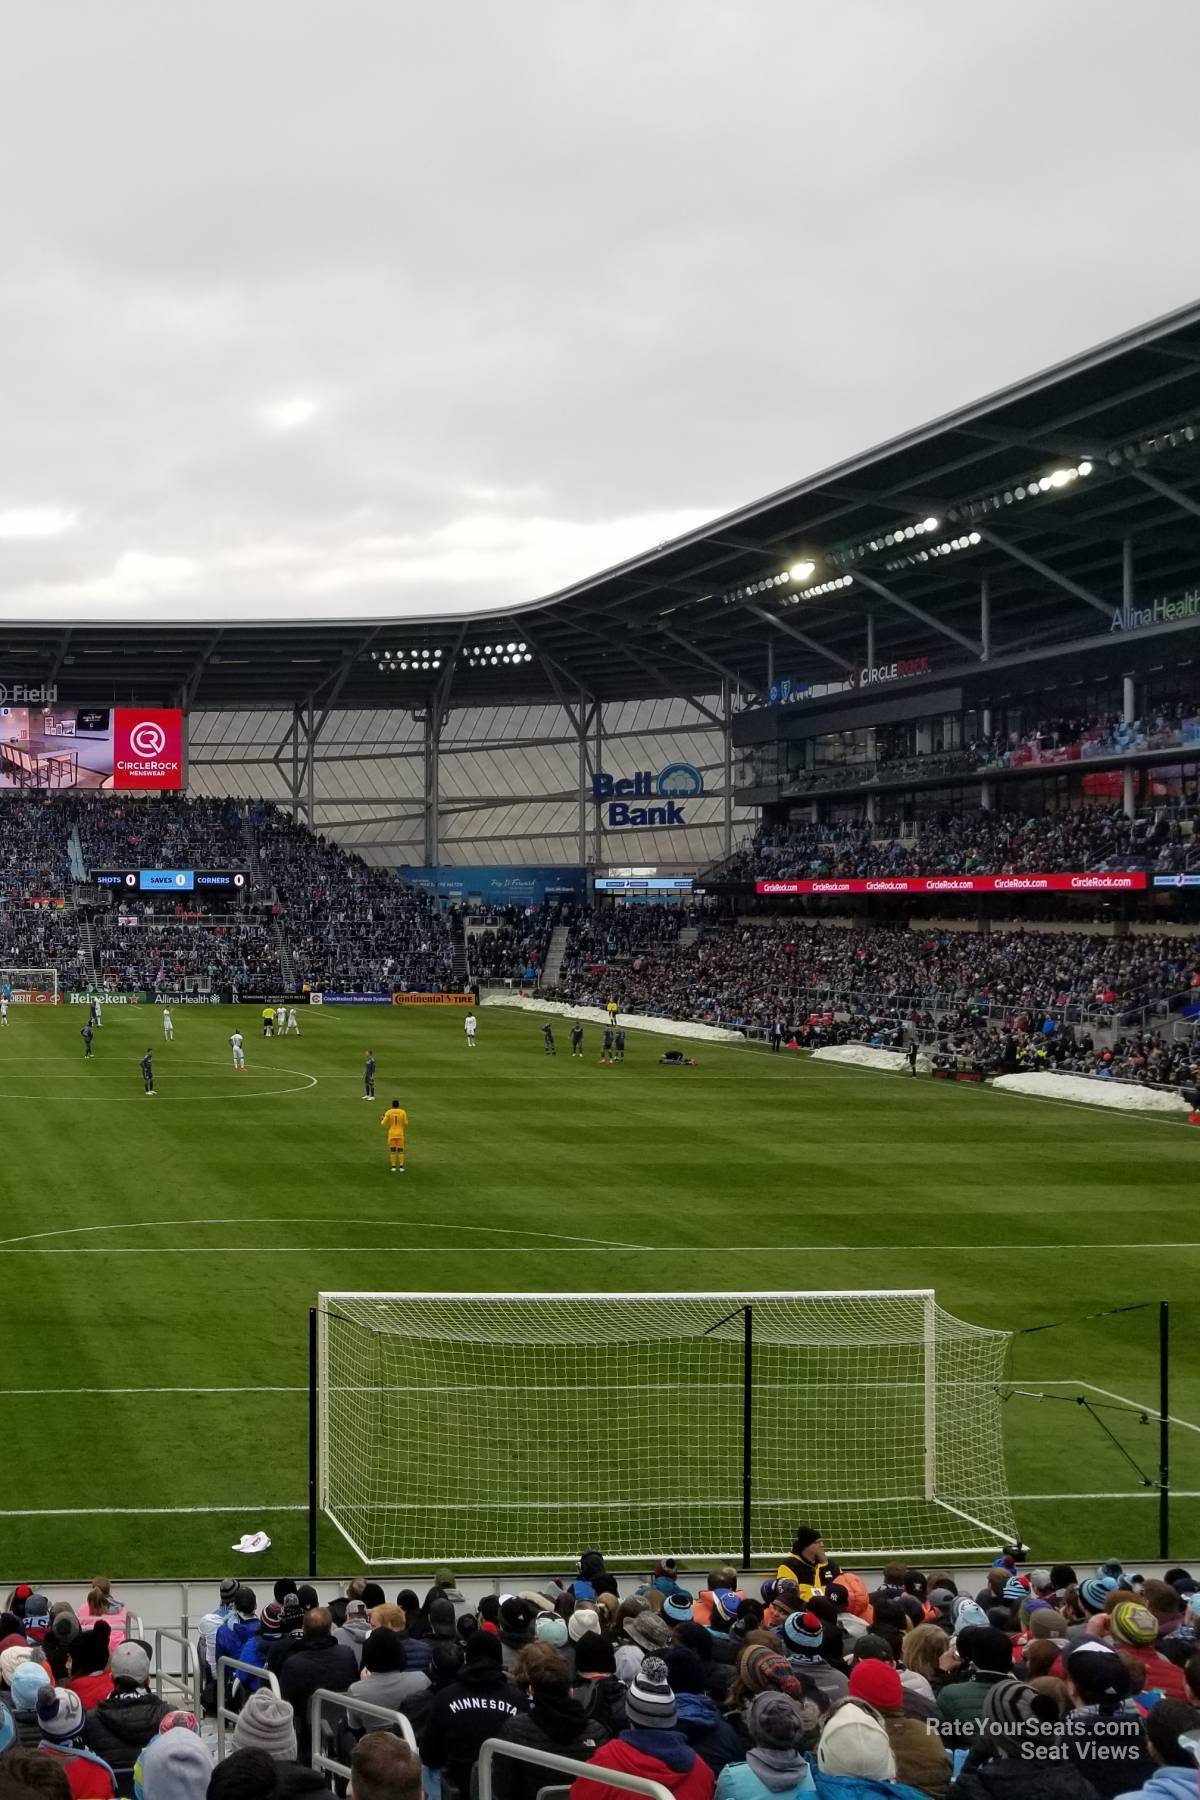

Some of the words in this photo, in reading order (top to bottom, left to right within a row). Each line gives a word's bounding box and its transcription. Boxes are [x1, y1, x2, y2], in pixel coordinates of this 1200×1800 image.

[13, 683, 58, 702] Field
[592, 771, 652, 797] Bell
[608, 800, 686, 826] Bank
[125, 874, 136, 886] 0
[175, 874, 186, 886] 0
[234, 874, 245, 886] 0
[866, 881, 908, 890] CircleRock.com
[926, 880, 974, 889] CircleRock.com
[994, 879, 1048, 889] CircleRock.com
[1071, 877, 1132, 887] CircleRock.com
[812, 882, 850, 891] CircleRock.com
[395, 993, 444, 1005] Continental
[449, 1697, 518, 1716] MINNESOTA
